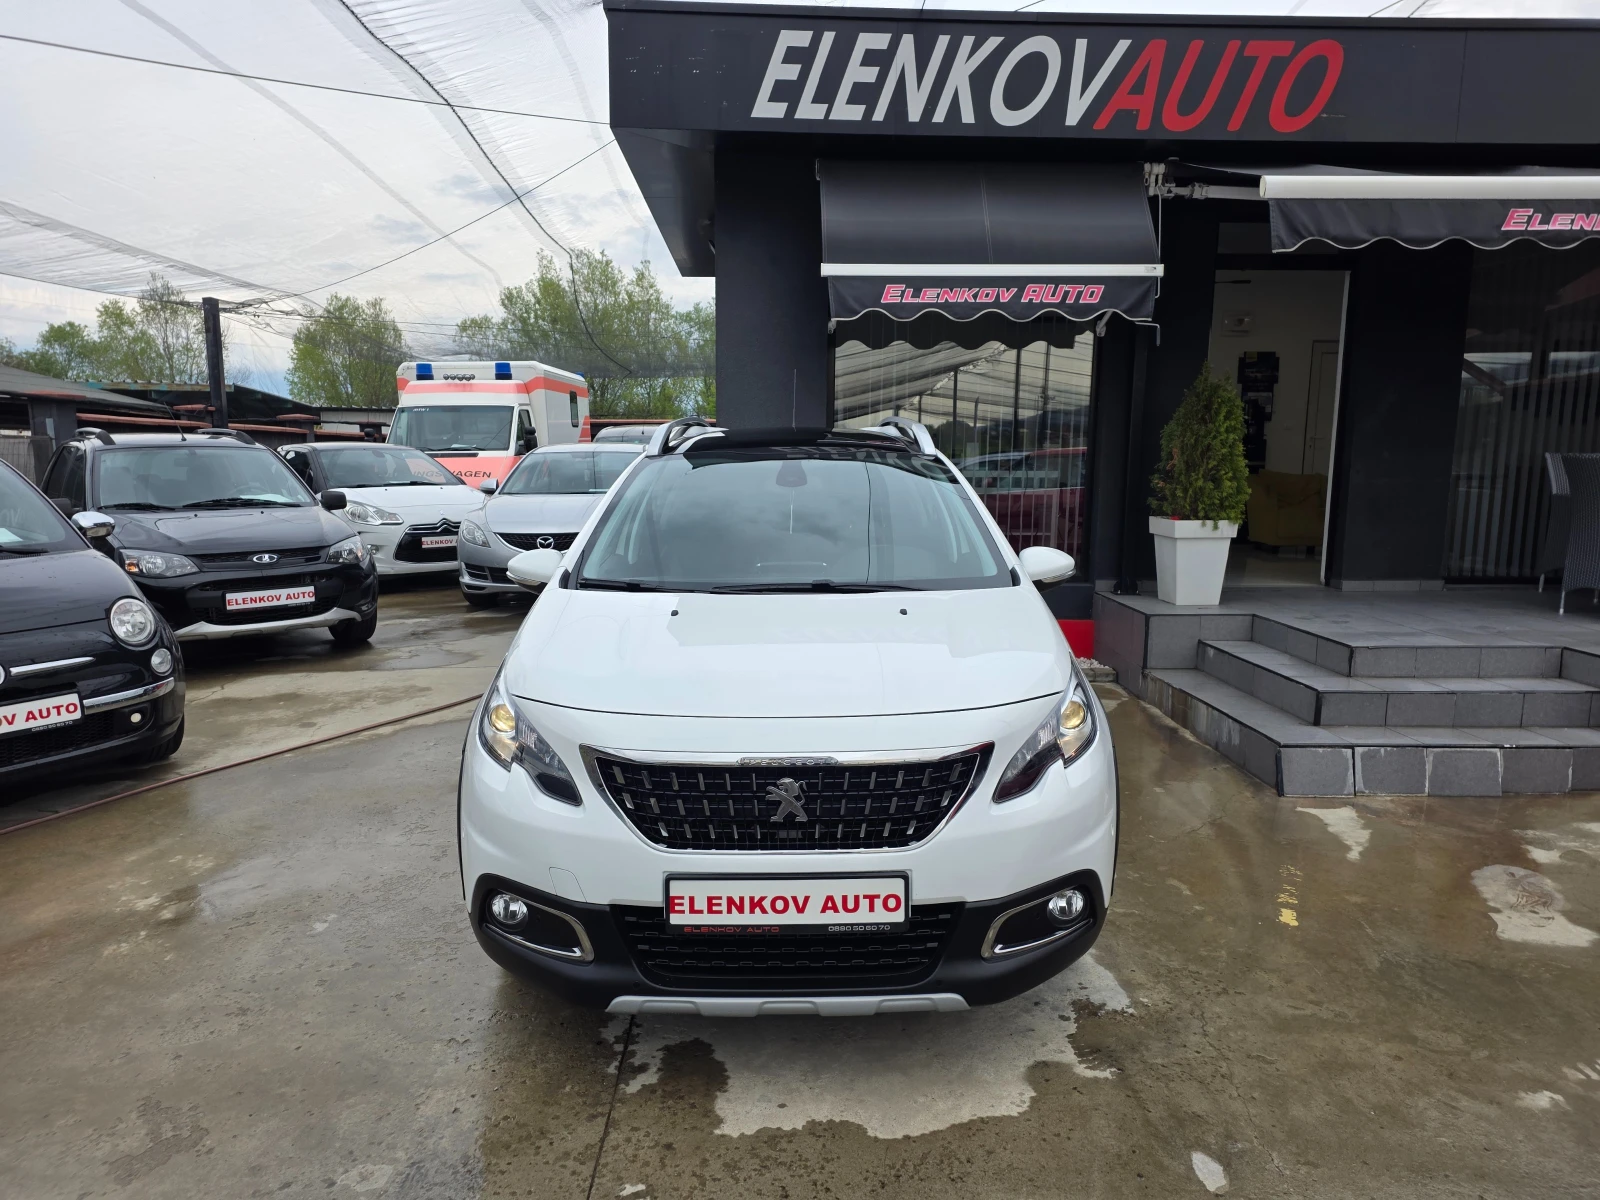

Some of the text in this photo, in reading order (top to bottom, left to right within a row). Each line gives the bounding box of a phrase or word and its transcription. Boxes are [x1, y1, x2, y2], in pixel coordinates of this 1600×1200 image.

[1501, 208, 1600, 231] ELEN
[881, 283, 1105, 303] ELENKOV AUTO
[227, 594, 282, 607] ELENKOV
[285, 590, 315, 601] AUTO
[25, 703, 78, 722] AUTO
[669, 893, 902, 915] ELENKOV AUTO
